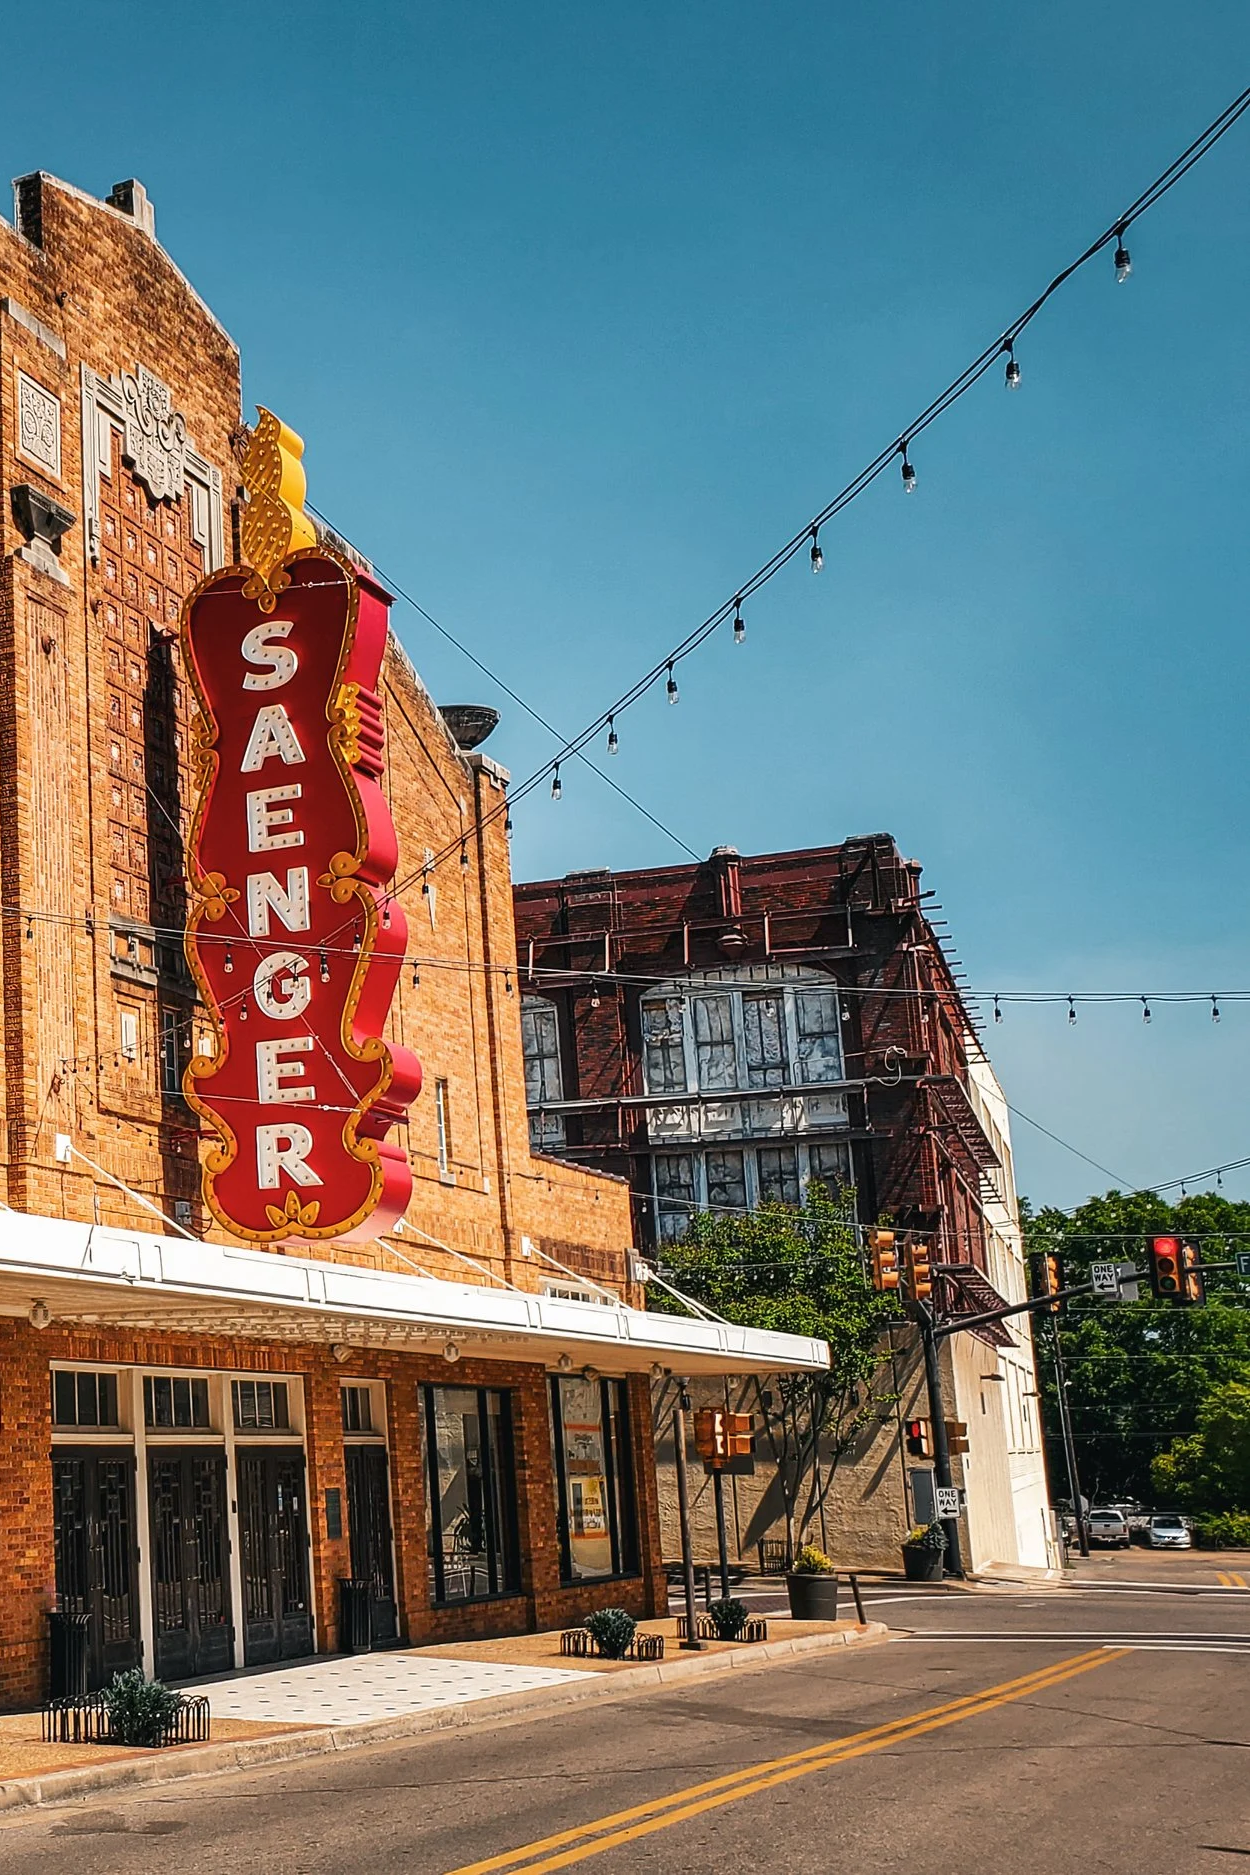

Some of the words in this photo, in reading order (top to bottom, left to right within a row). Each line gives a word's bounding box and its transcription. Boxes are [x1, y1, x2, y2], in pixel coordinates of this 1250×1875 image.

[241, 620, 324, 1189] SAENGER
[1093, 1264, 1113, 1273] ONE
[1094, 1273, 1114, 1282] WAY
[938, 1490, 956, 1498] ONE
